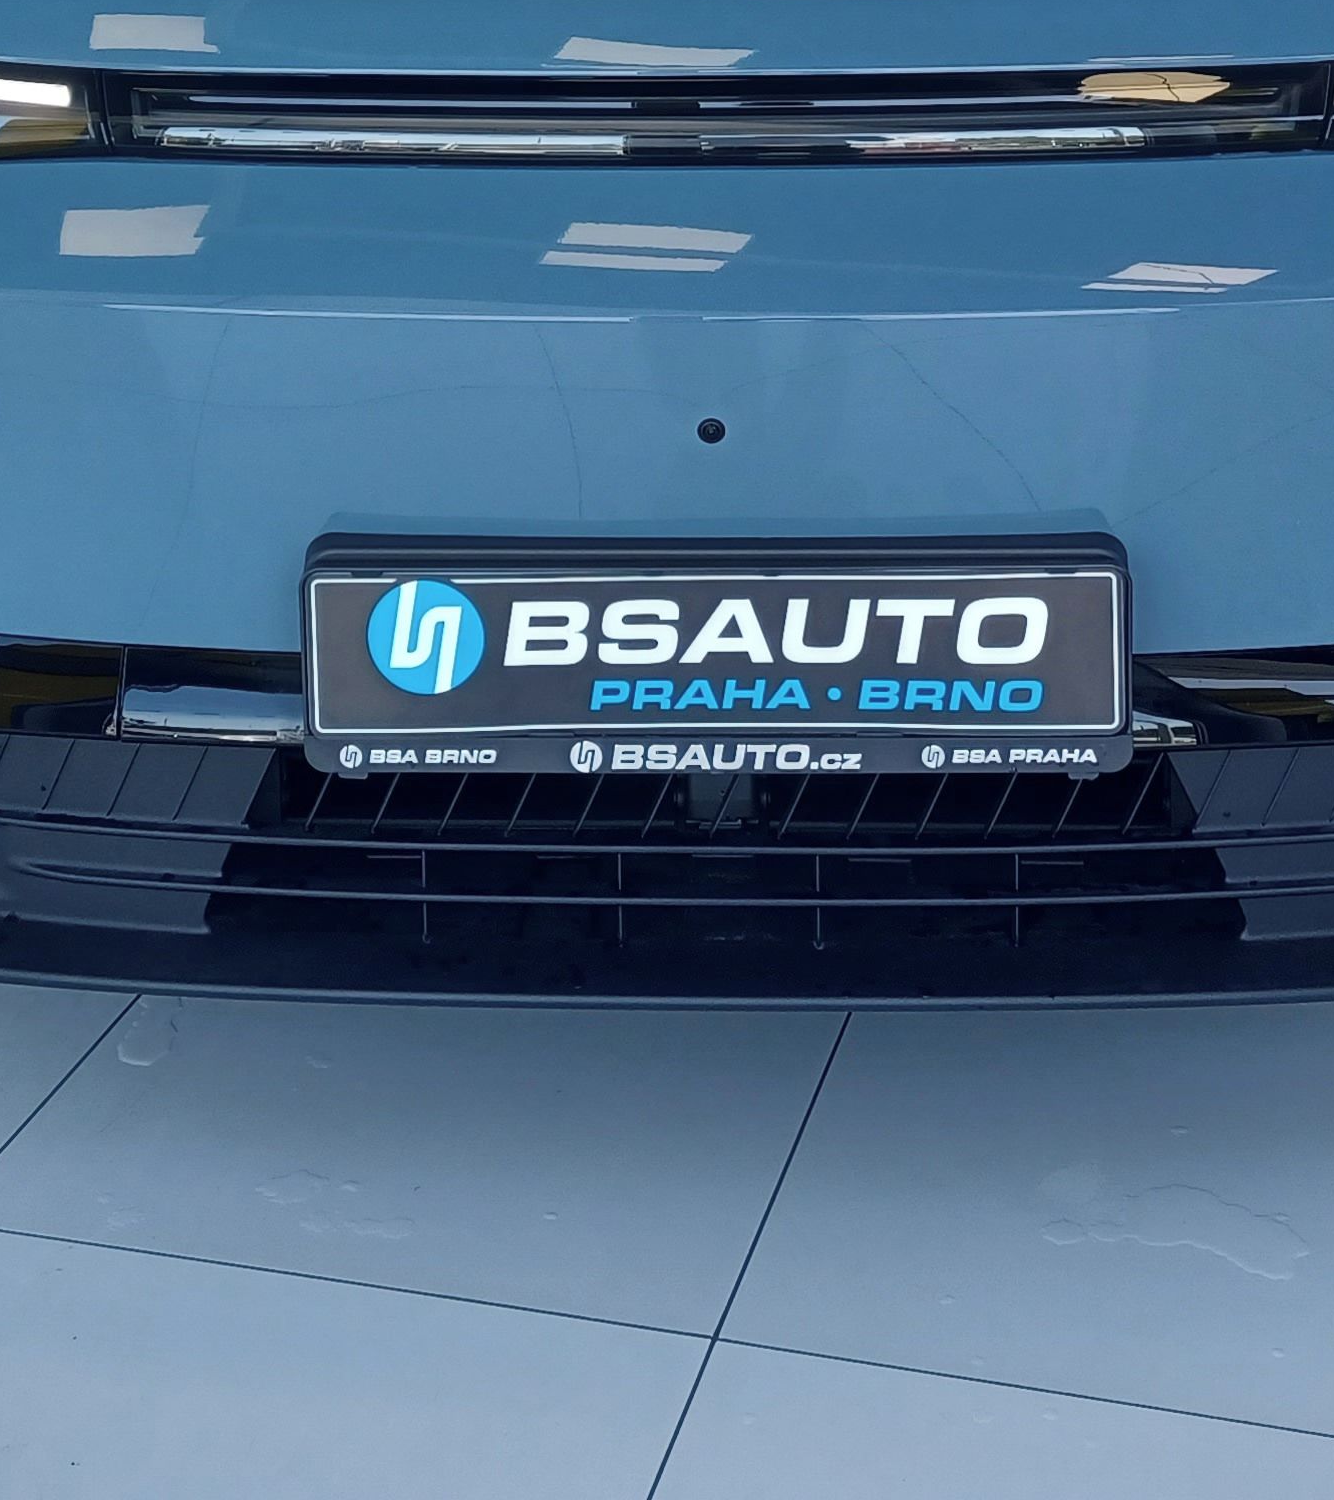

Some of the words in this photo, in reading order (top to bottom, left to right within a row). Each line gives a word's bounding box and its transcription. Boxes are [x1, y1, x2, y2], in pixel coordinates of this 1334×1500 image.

[503, 596, 1049, 667] BSAUTO
[588, 678, 812, 711] PRAHA
[857, 679, 1044, 712] BRNO
[369, 749, 418, 765] BSA
[424, 749, 497, 765] BRNO
[611, 743, 863, 771] BSAUTO.cz
[951, 748, 1003, 765] BSA
[1008, 748, 1098, 765] PRAHA
